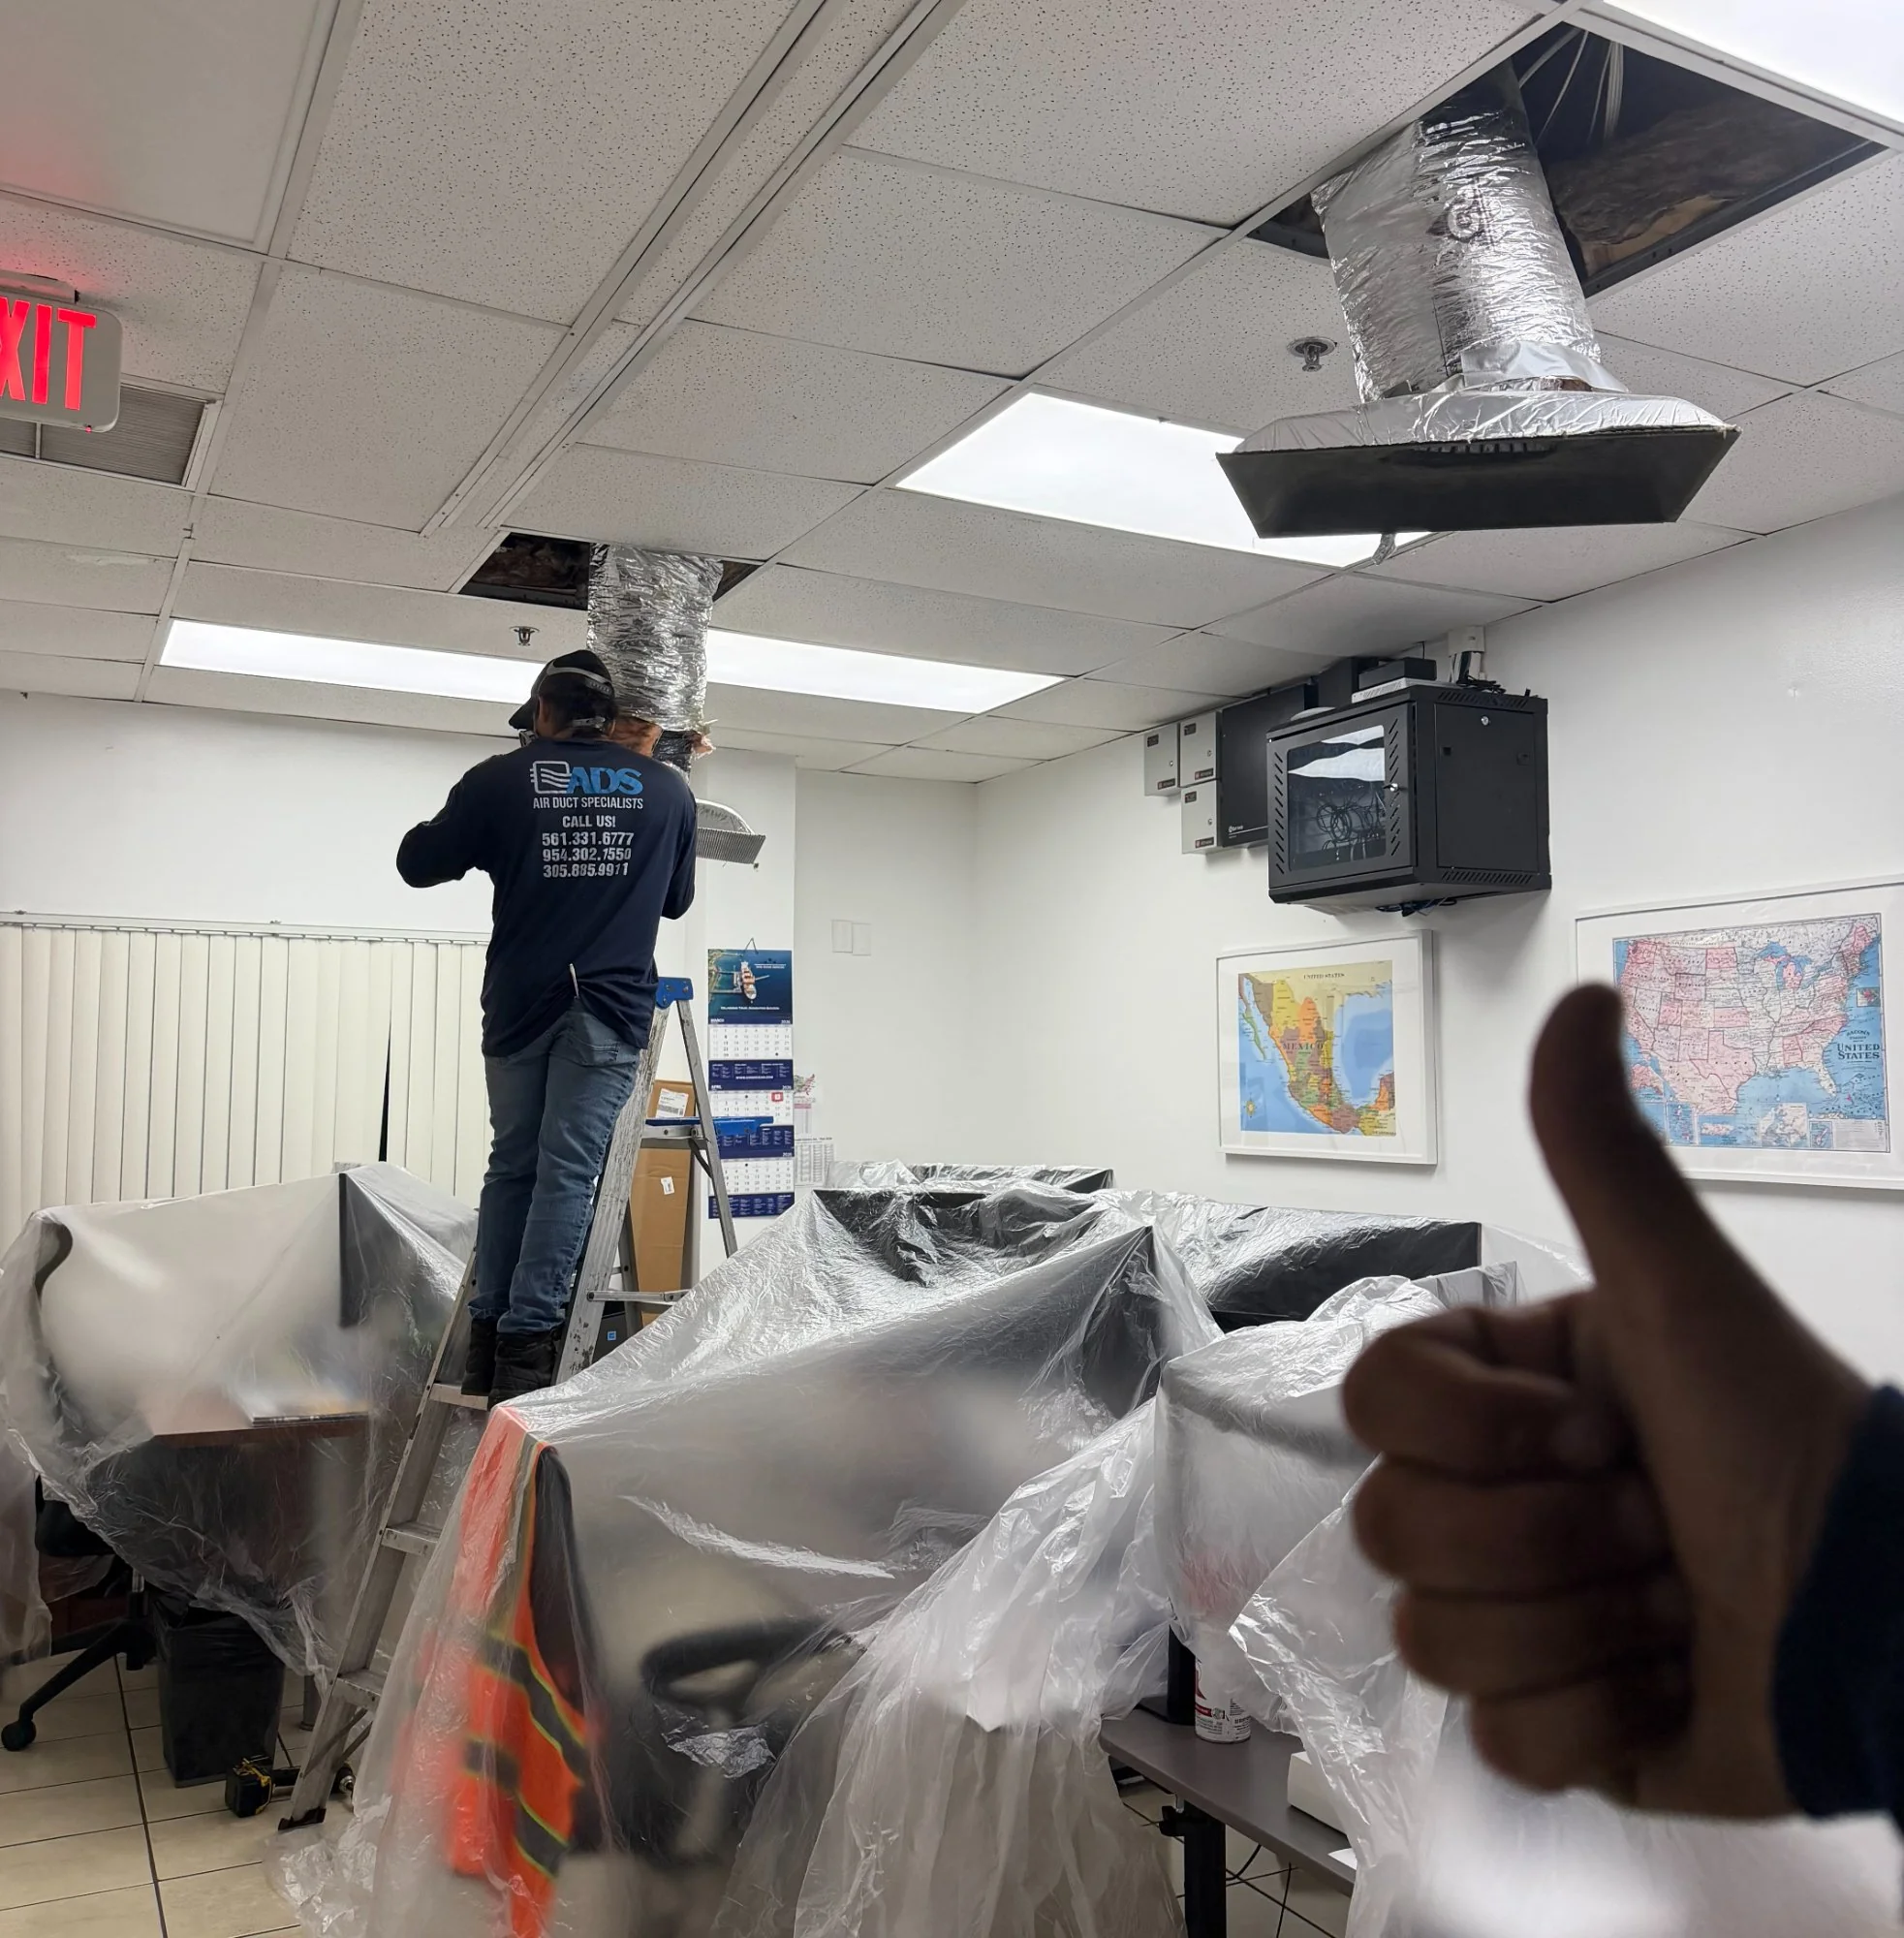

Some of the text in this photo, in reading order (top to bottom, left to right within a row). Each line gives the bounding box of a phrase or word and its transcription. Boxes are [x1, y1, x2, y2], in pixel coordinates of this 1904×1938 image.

[0, 297, 96, 411] XIT
[566, 766, 643, 795] ADS
[533, 797, 643, 809] AIR DUCT SPECIALISTS
[562, 815, 616, 828] CALL US!
[542, 831, 635, 846] 561.331.6777
[1283, 1042, 1324, 1050] MEXICO
[1837, 1043, 1881, 1051] UNITED
[1838, 1050, 1881, 1060] STATES
